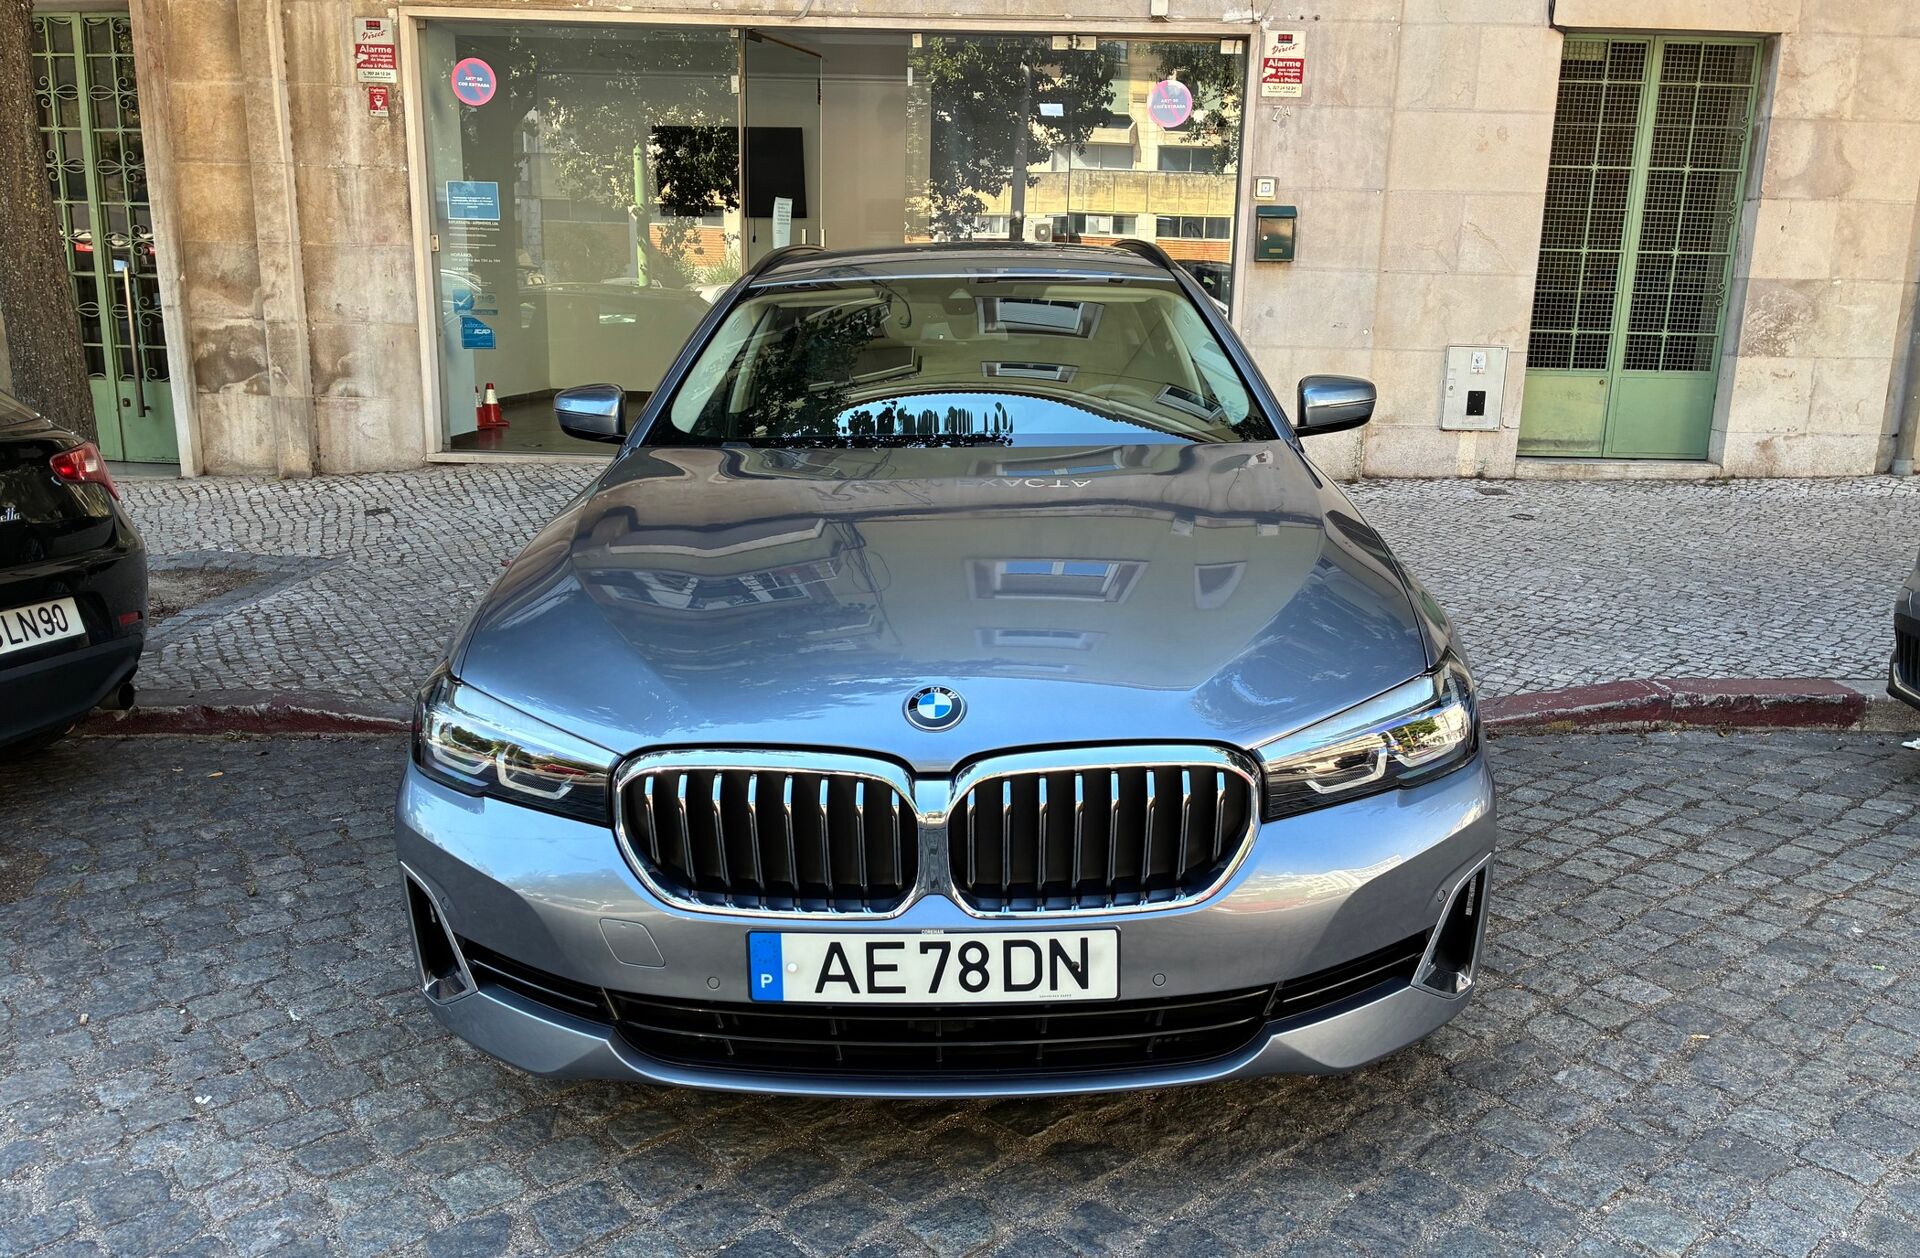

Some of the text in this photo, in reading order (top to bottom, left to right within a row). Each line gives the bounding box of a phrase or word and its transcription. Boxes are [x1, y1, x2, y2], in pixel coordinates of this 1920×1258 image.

[360, 45, 392, 53] Alarme
[1267, 59, 1301, 67] Alarme
[913, 687, 958, 699] BMW
[760, 973, 773, 988] P
